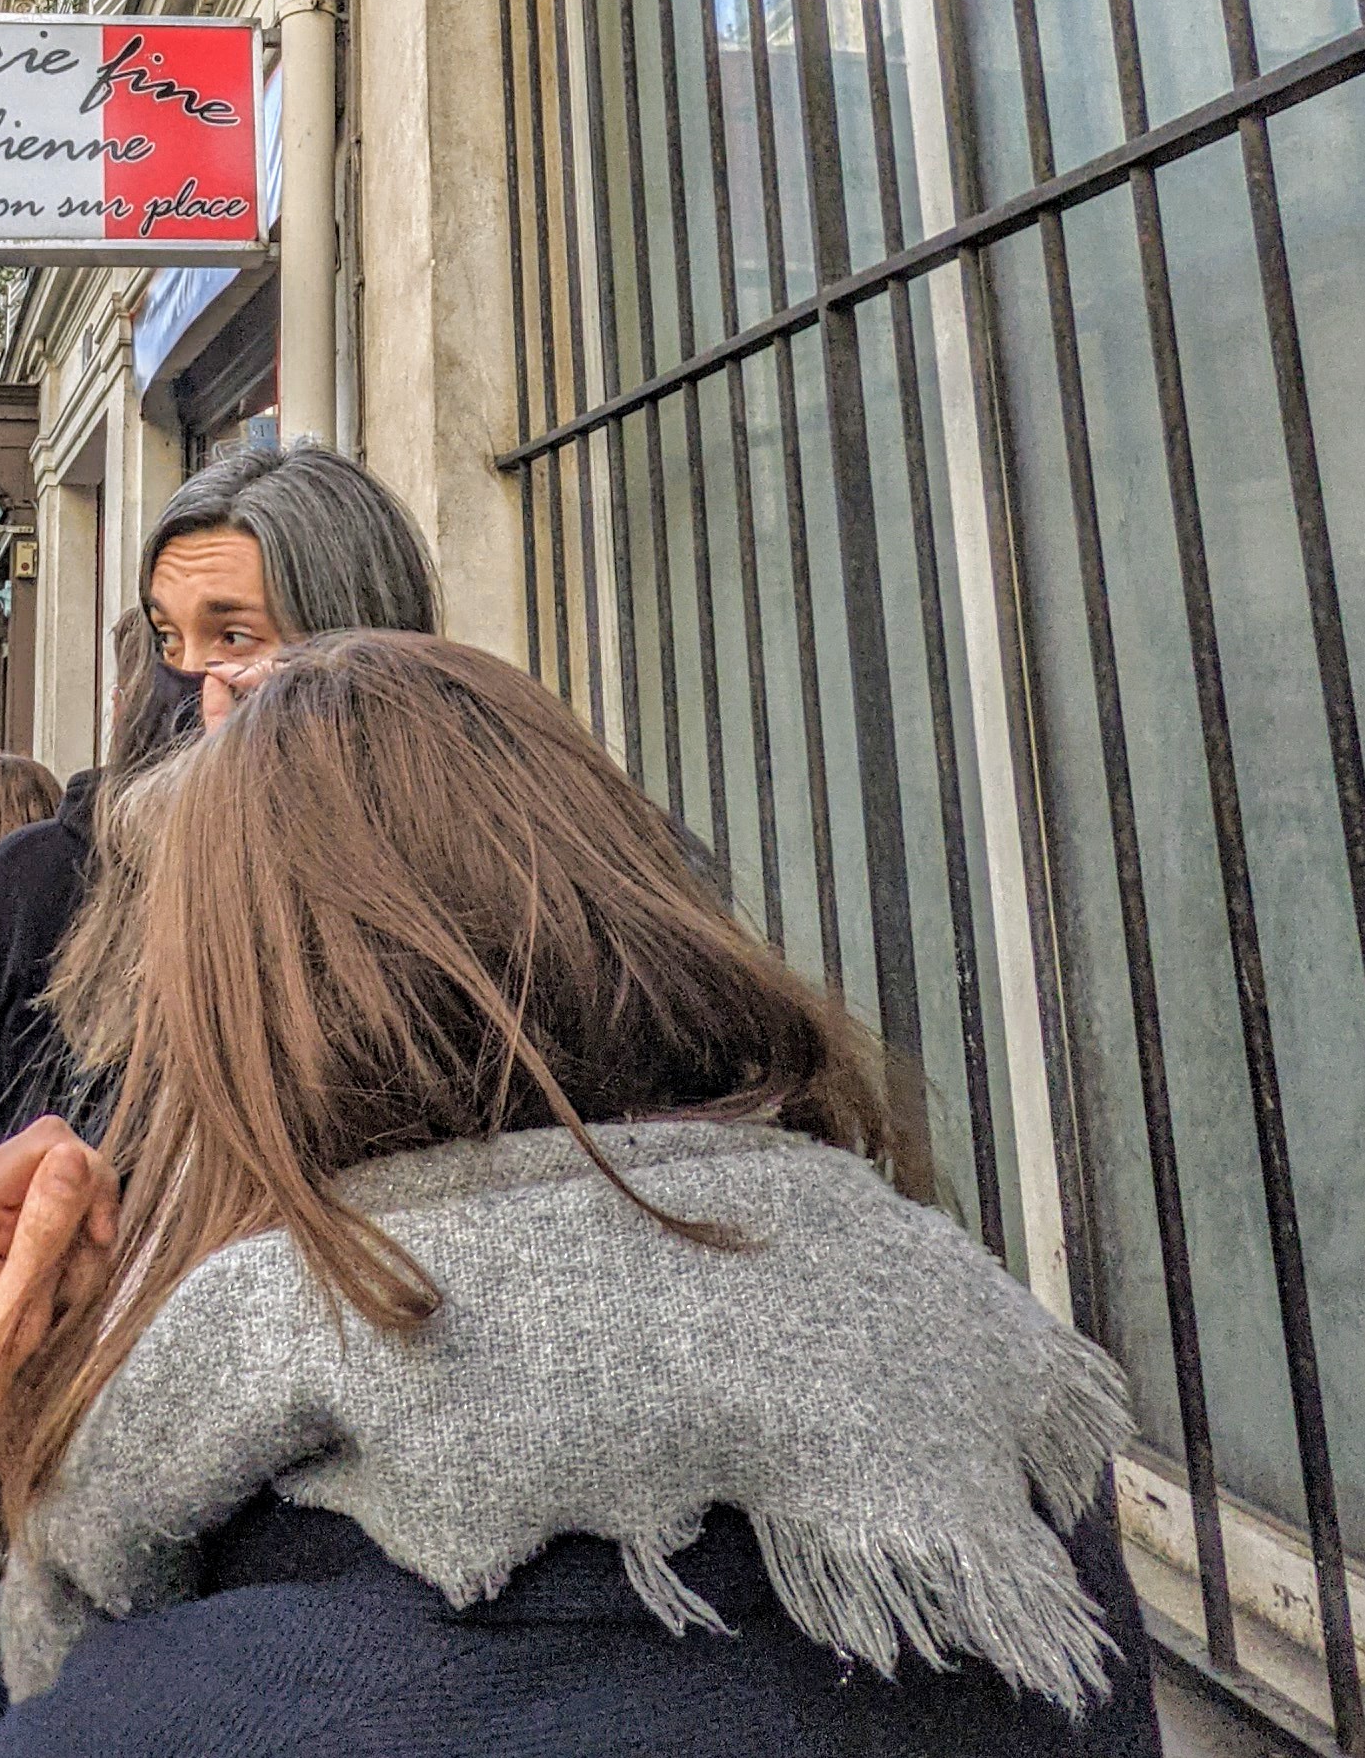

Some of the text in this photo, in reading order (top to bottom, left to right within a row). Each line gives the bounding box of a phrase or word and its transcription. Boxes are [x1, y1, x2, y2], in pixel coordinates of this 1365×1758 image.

[80, 34, 239, 125] fine
[57, 194, 133, 218] sur
[141, 178, 248, 237] place
